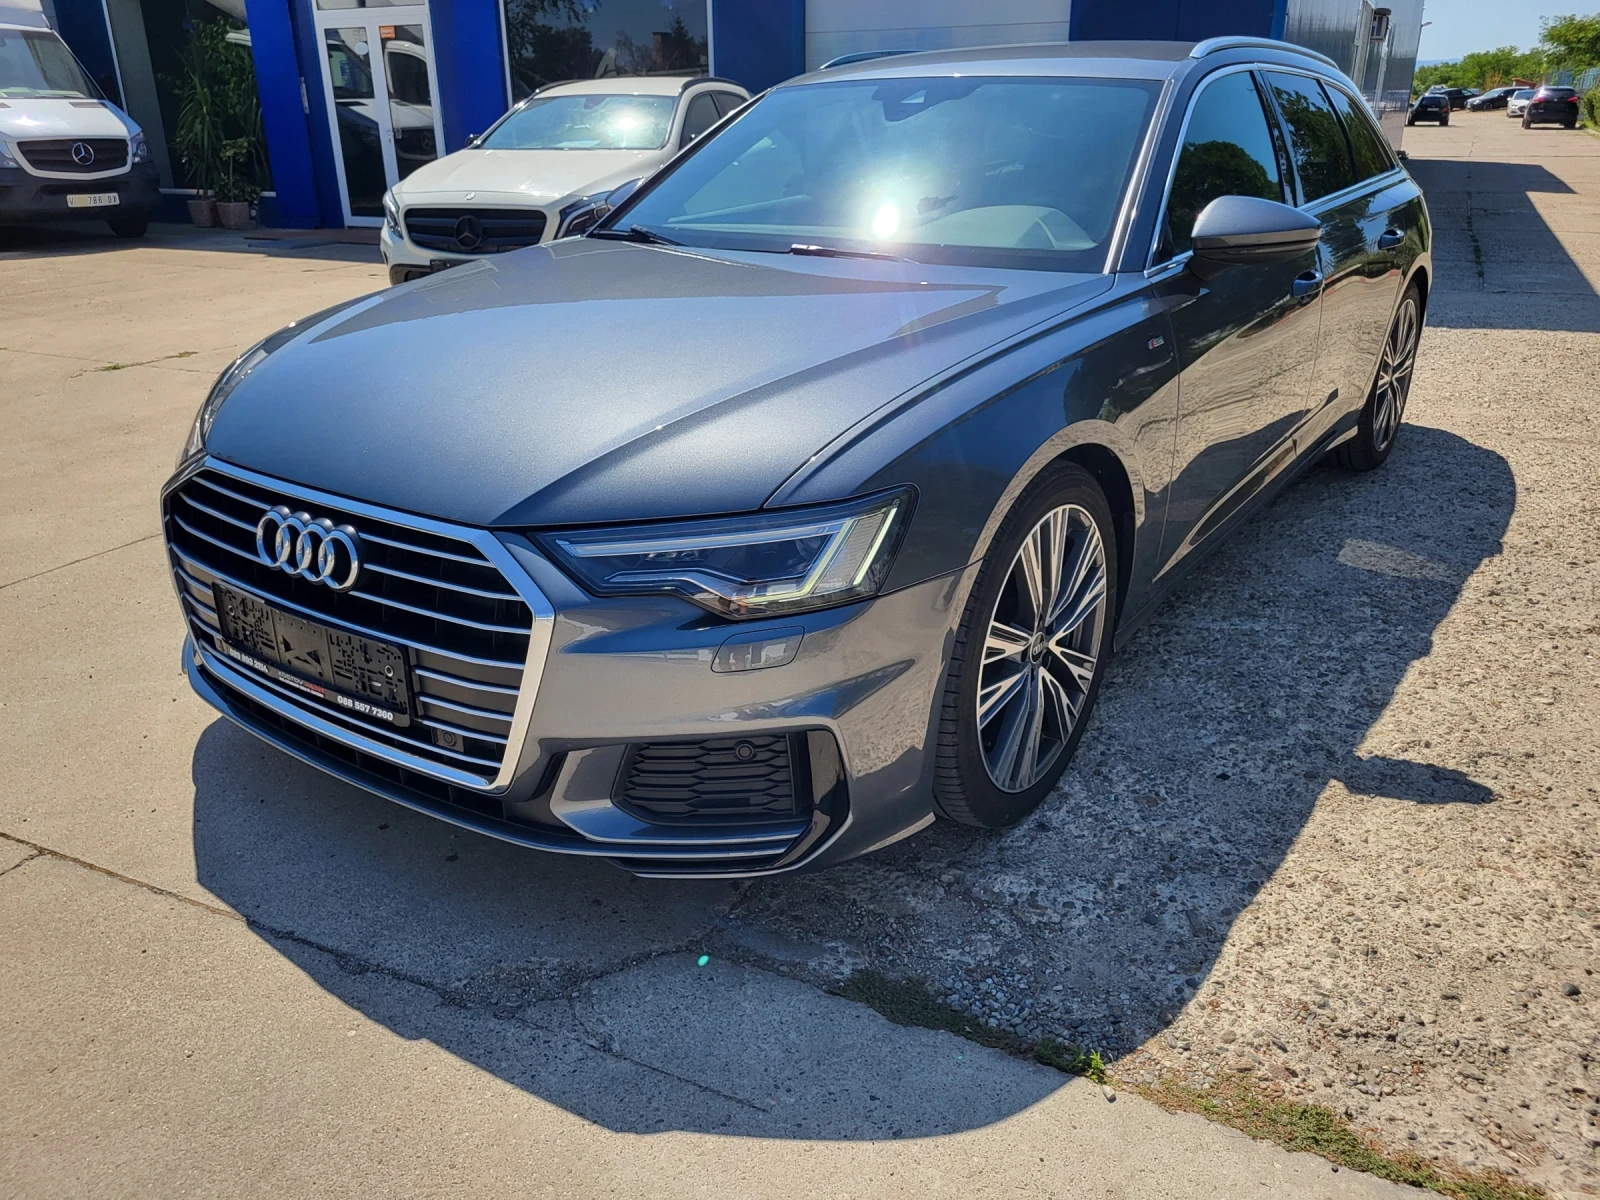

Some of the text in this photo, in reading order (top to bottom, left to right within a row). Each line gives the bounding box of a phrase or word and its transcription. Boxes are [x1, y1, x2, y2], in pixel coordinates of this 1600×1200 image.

[88, 196, 103, 205] 786
[337, 695, 394, 721] 088 557 7360
